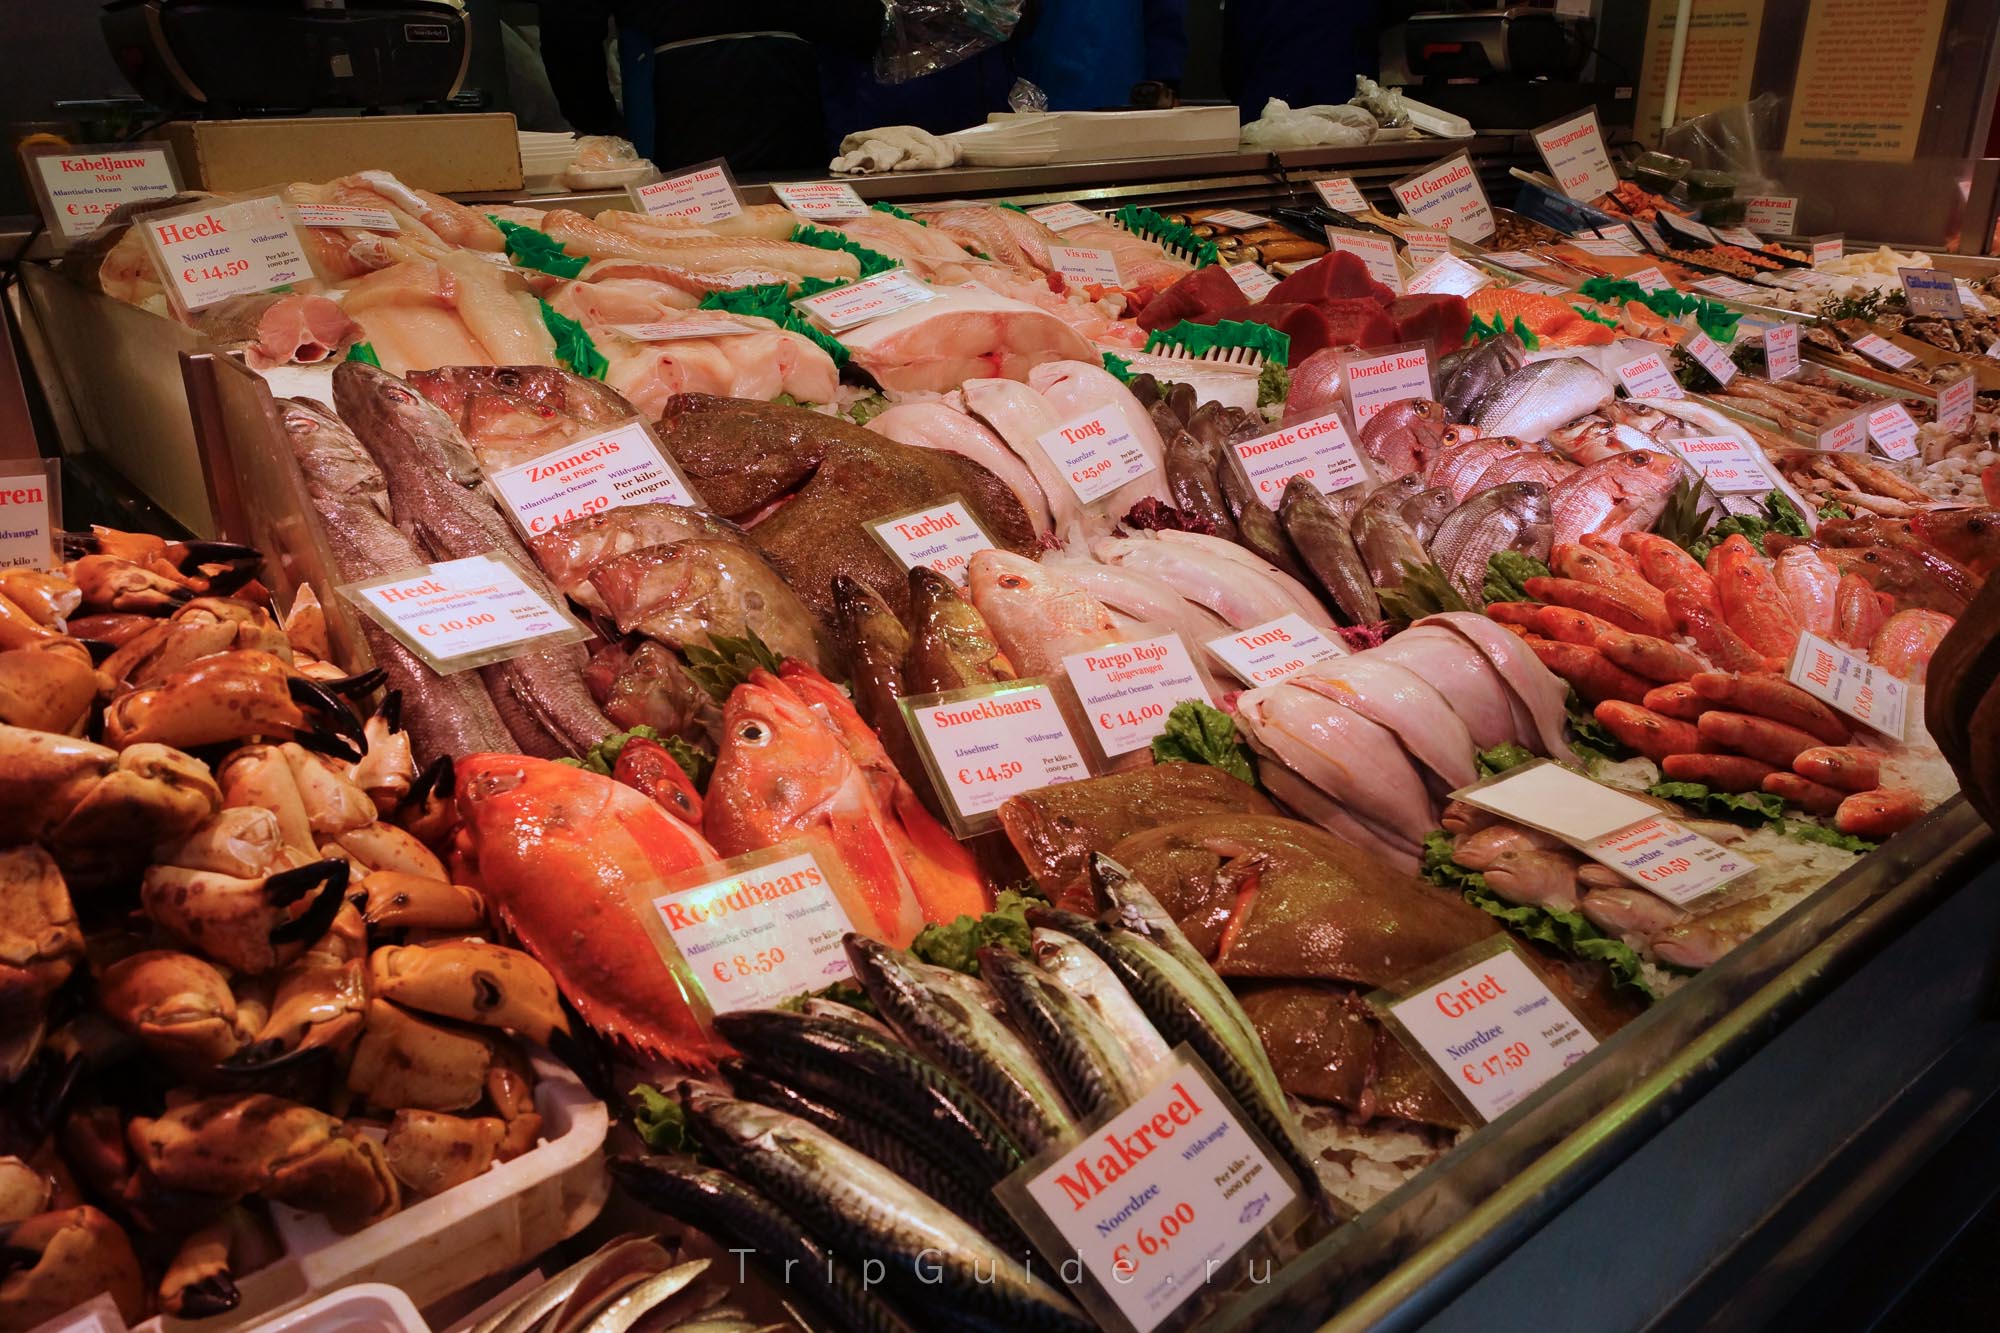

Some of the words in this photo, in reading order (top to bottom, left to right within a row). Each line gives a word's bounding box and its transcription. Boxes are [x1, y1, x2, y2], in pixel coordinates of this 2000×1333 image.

[1543, 125, 1595, 151] Steurgarnalen
[60, 158, 146, 173] Kabeljauw
[97, 174, 122, 182] Moot
[641, 177, 693, 197] Kabeljauw
[694, 171, 721, 182] Haas
[1401, 185, 1423, 205] Pel
[1421, 165, 1471, 195] Garnalen
[67, 204, 78, 216] €
[1411, 199, 1440, 216] Noordzee
[1440, 189, 1456, 201] Wild
[156, 215, 227, 246] Heek
[250, 232, 289, 245] Wildvangst
[182, 246, 232, 264] Noordzee
[265, 255, 279, 263] Per
[280, 251, 292, 260] kilo
[1064, 249, 1080, 257] Vis
[1081, 250, 1099, 259] mix
[184, 270, 199, 284] €
[202, 259, 249, 280] 14,50
[1349, 360, 1394, 380] Dorade
[1396, 356, 1426, 370] Rose
[1622, 357, 1659, 378] Gamba's
[1358, 405, 1366, 416] €
[1060, 420, 1106, 446] Tong
[1238, 434, 1296, 459] Dorade
[1297, 419, 1339, 440] Grise
[1066, 449, 1097, 467] Noordzee
[1679, 441, 1740, 453] Zeebaars
[526, 439, 621, 484] Zonnevis
[606, 460, 654, 480] Wildvangst
[1072, 471, 1083, 483] €
[1083, 459, 1112, 479] 25,00
[559, 472, 576, 486] St
[611, 476, 636, 493] Per
[619, 475, 672, 502] 1000grm
[1260, 481, 1272, 493] €
[518, 487, 567, 512] Atlantische
[565, 478, 599, 497] Oceaan
[530, 516, 548, 534] €
[549, 495, 610, 527] 14,50
[895, 511, 961, 542] Tarbot
[13, 557, 31, 567] kilo
[909, 542, 949, 561] Noordzee
[378, 580, 448, 605] Heek
[417, 624, 437, 637] €
[438, 613, 496, 634] 10,00
[1236, 628, 1292, 652] Tong
[1084, 651, 1133, 673] Pargo
[1132, 643, 1169, 662] Rojo
[1807, 648, 1838, 688] Rouget
[1107, 663, 1165, 683] Lijngevangen
[1252, 670, 1267, 683] €
[1265, 659, 1305, 679] 20,00
[1086, 689, 1129, 706] Atlantische
[1127, 683, 1155, 696] Oceaan
[1159, 676, 1193, 688] Wildvangst
[933, 697, 1043, 729] Snoekbaars
[1100, 713, 1115, 730] €
[1117, 703, 1165, 728] 14,00
[1025, 731, 1064, 745] Wildvangst
[1055, 755, 1068, 764] kilo
[1062, 761, 1079, 771] gram
[958, 769, 974, 785] €
[975, 760, 1023, 783] 14,50
[1621, 849, 1665, 869] Noordzee
[1638, 869, 1658, 882] €
[1654, 857, 1693, 879] 10,50
[660, 866, 823, 932] Roodbaars
[687, 930, 740, 957] Atlantische
[713, 961, 734, 984] €
[733, 947, 787, 977] 8,50
[1435, 974, 1508, 1019] Griet
[1446, 1024, 1505, 1062] Noordzee
[1462, 1063, 1485, 1086] €
[1482, 1041, 1531, 1076] 17,50
[1054, 1082, 1203, 1212] Makreel
[1182, 1121, 1230, 1161] Wildvangst
[1214, 1170, 1232, 1188] Per
[1229, 1158, 1247, 1176] kilo
[1222, 1180, 1245, 1200] 1000
[1242, 1162, 1265, 1185] gram
[1095, 1183, 1161, 1239] Noordzee
[1113, 1243, 1140, 1277] €
[1136, 1202, 1197, 1256] 6,00
